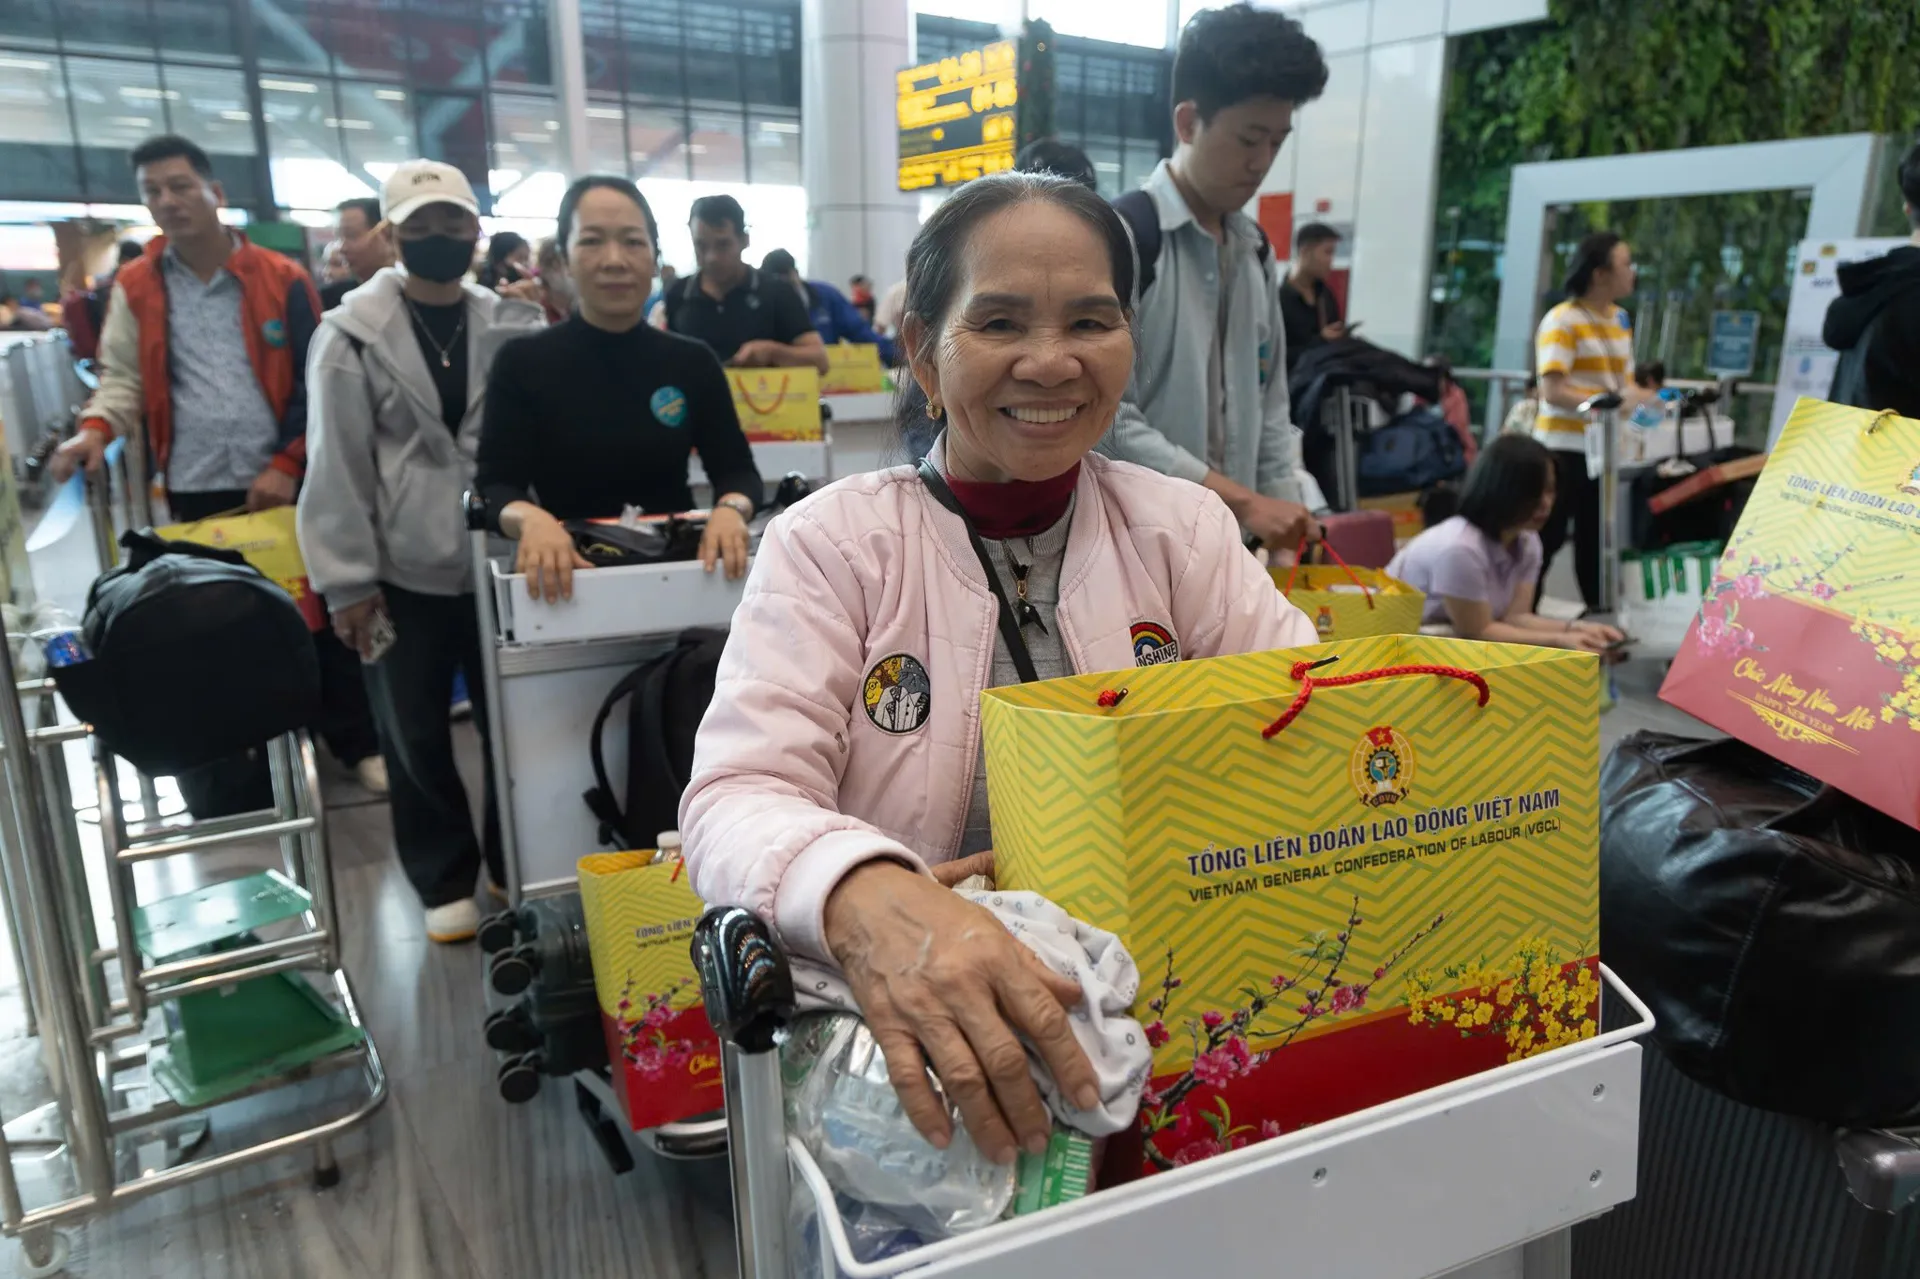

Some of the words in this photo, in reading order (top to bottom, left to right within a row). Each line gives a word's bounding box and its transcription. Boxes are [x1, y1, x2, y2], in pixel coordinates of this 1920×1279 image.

[1187, 841, 1247, 876] TỔNG
[1254, 835, 1302, 864] LIÊN
[1308, 824, 1366, 854] ĐOÀN
[1372, 816, 1408, 842] LAO
[1414, 806, 1468, 836] ĐỘNG
[1473, 796, 1513, 824] VIỆT
[1519, 788, 1560, 815] NAM
[1189, 877, 1258, 902] VIETNAM
[1263, 865, 1330, 888] GENERAL
[1334, 840, 1446, 875] CONFEDERATION
[1451, 837, 1467, 851] OF
[1471, 826, 1521, 847] LABOUR
[1524, 817, 1562, 840] (VGCL)
